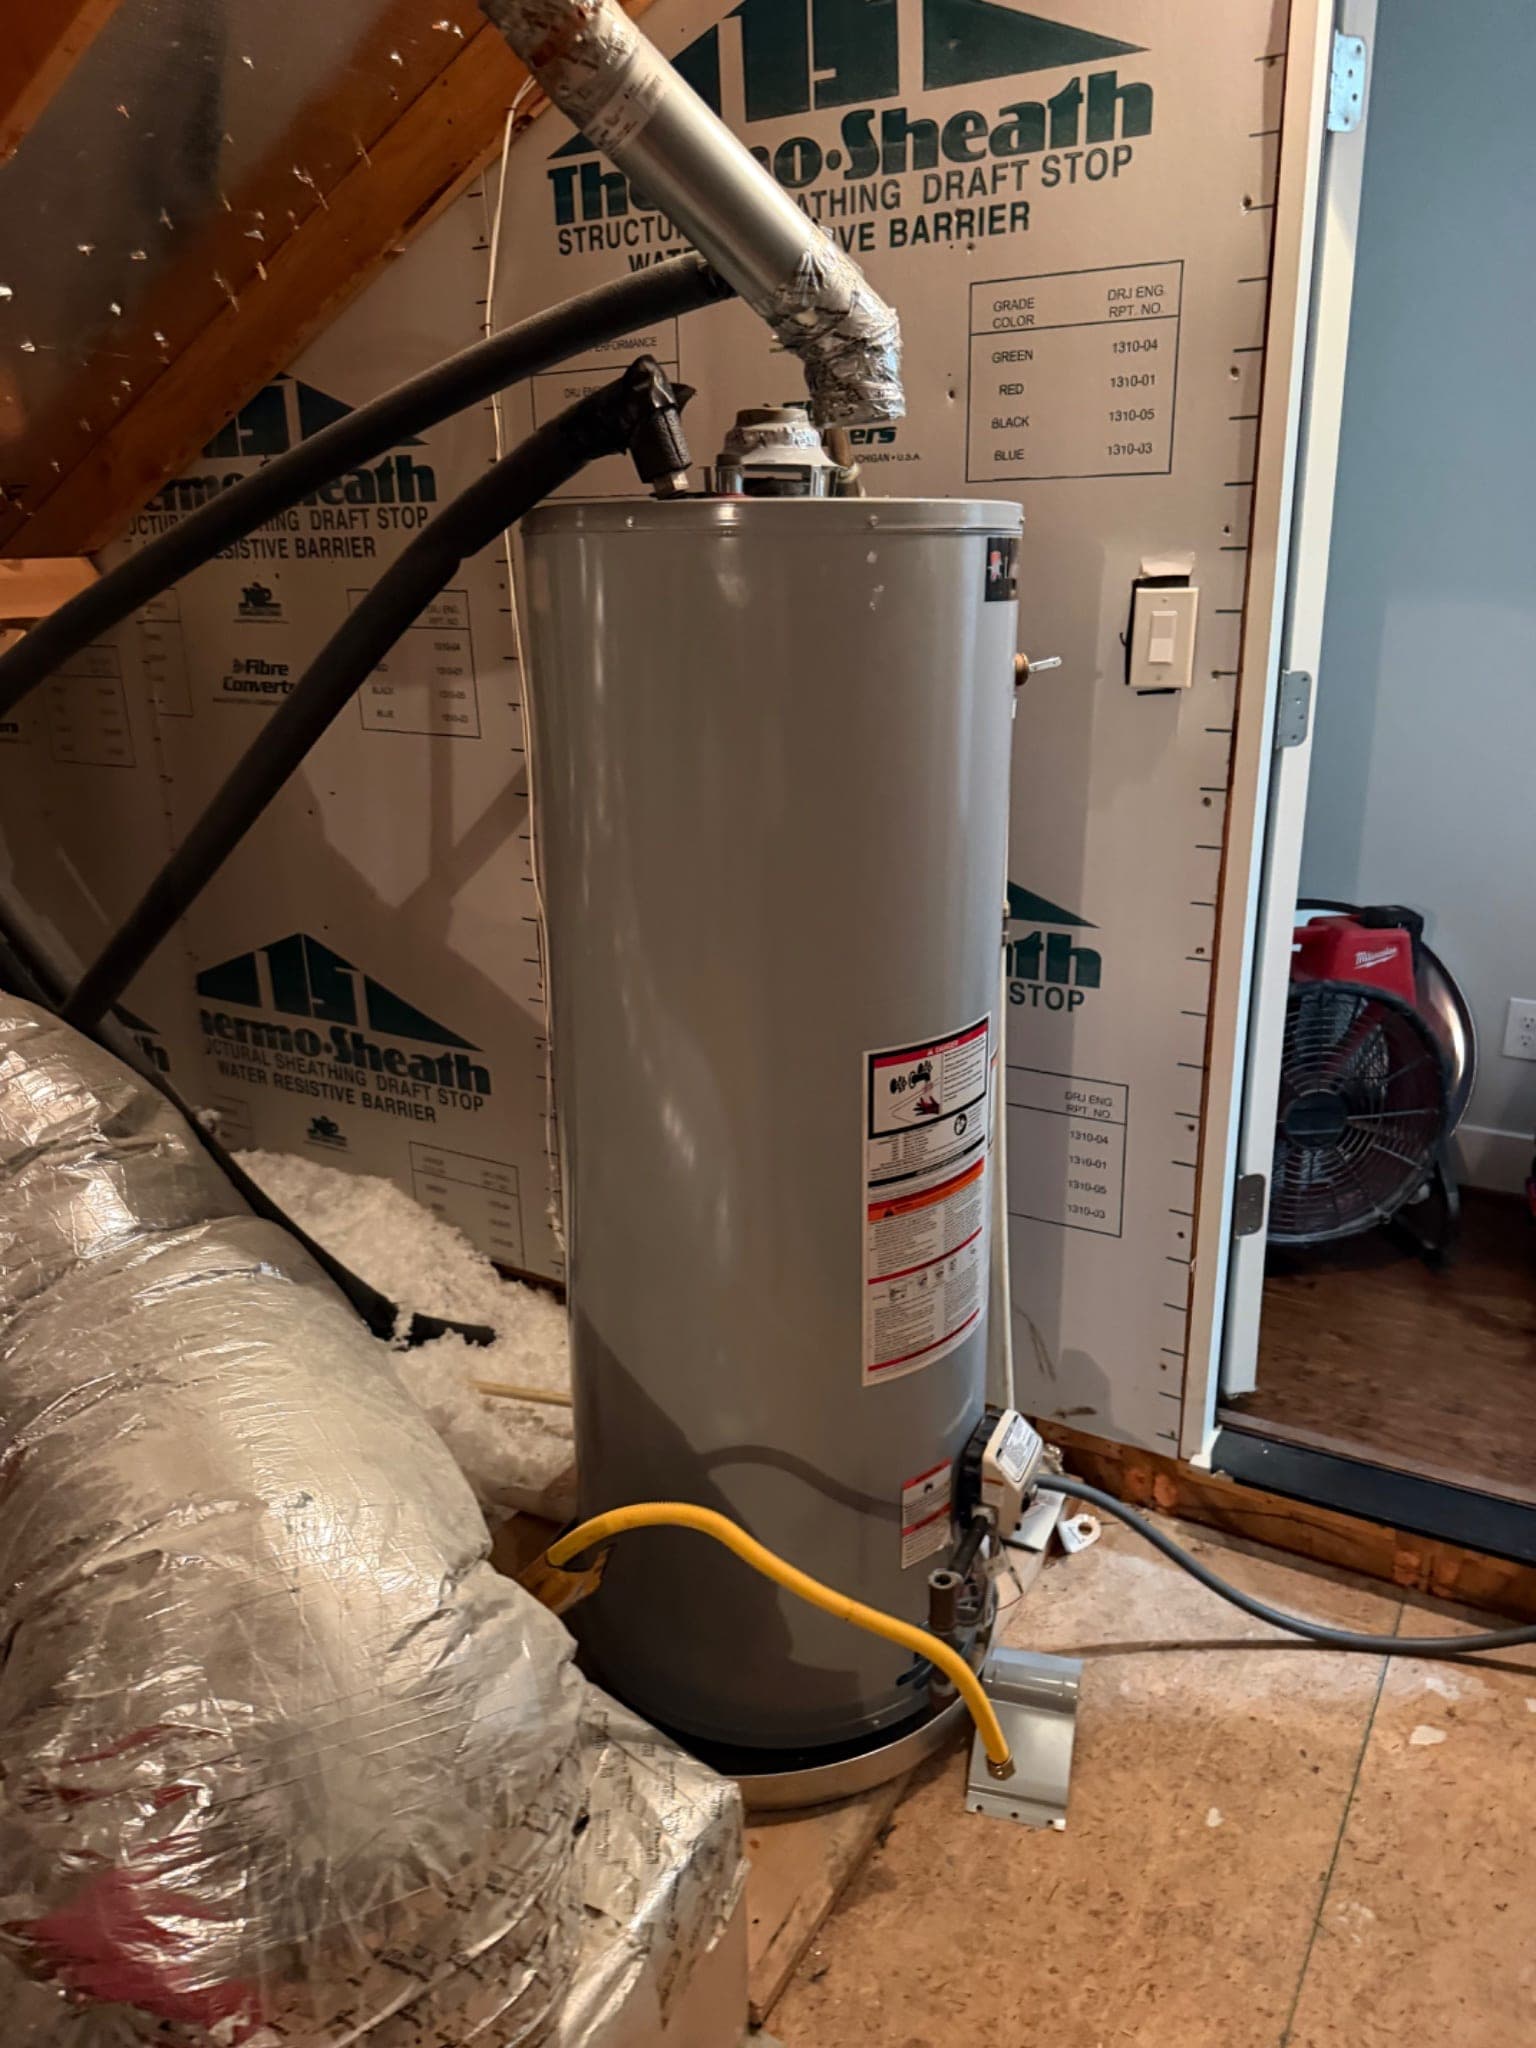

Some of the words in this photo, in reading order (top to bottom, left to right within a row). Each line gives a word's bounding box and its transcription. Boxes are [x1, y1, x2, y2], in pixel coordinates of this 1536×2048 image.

[559, 213, 684, 256] STRUCTU
[923, 159, 1030, 205] DRAFT
[1041, 144, 1133, 188] STOP
[889, 201, 1030, 248] BARRIER
[993, 297, 1035, 313] GRADE
[992, 314, 1035, 329] COLOR
[1112, 339, 1158, 354] 1310-04
[991, 349, 1033, 364] GREEN
[1110, 374, 1156, 388] 1310-01
[998, 383, 1025, 396] RED
[991, 416, 1030, 430] BLACK
[1109, 408, 1155, 422] 1310-05
[993, 448, 1025, 461] BLUE
[310, 508, 371, 531] DRAFT
[376, 505, 429, 530] STOP
[215, 537, 289, 560] ESISTIVE
[294, 535, 376, 559] BARRIER
[245, 659, 289, 676] Fibre
[1009, 981, 1085, 1012] STOP
[275, 1052, 367, 1085] SHEATHING
[375, 1074, 433, 1101] DRAFT
[438, 1087, 484, 1112] STOP
[216, 1060, 268, 1085] WATER
[273, 1072, 356, 1105] RESISTIVE
[361, 1090, 437, 1124] BARRIER
